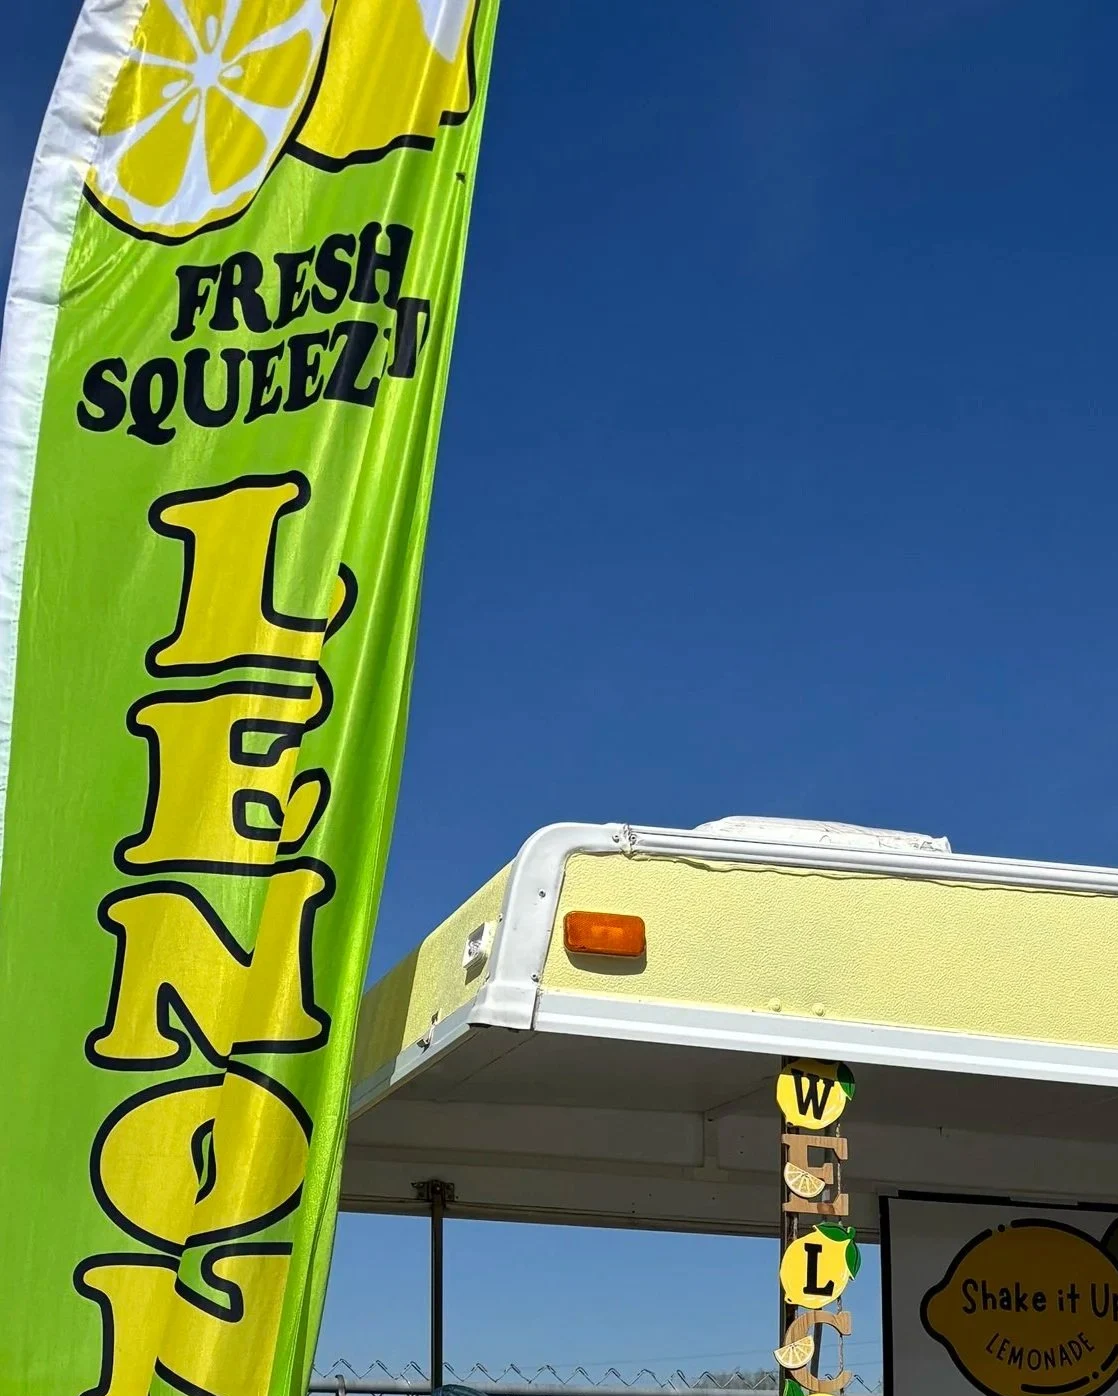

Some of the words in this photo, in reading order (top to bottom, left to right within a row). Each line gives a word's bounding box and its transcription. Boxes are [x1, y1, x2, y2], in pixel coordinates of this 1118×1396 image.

[171, 223, 413, 340] FRESH
[961, 1278, 1047, 1314] Shake
[1057, 1283, 1080, 1314] it
[985, 1331, 1095, 1371] LEMONADE
